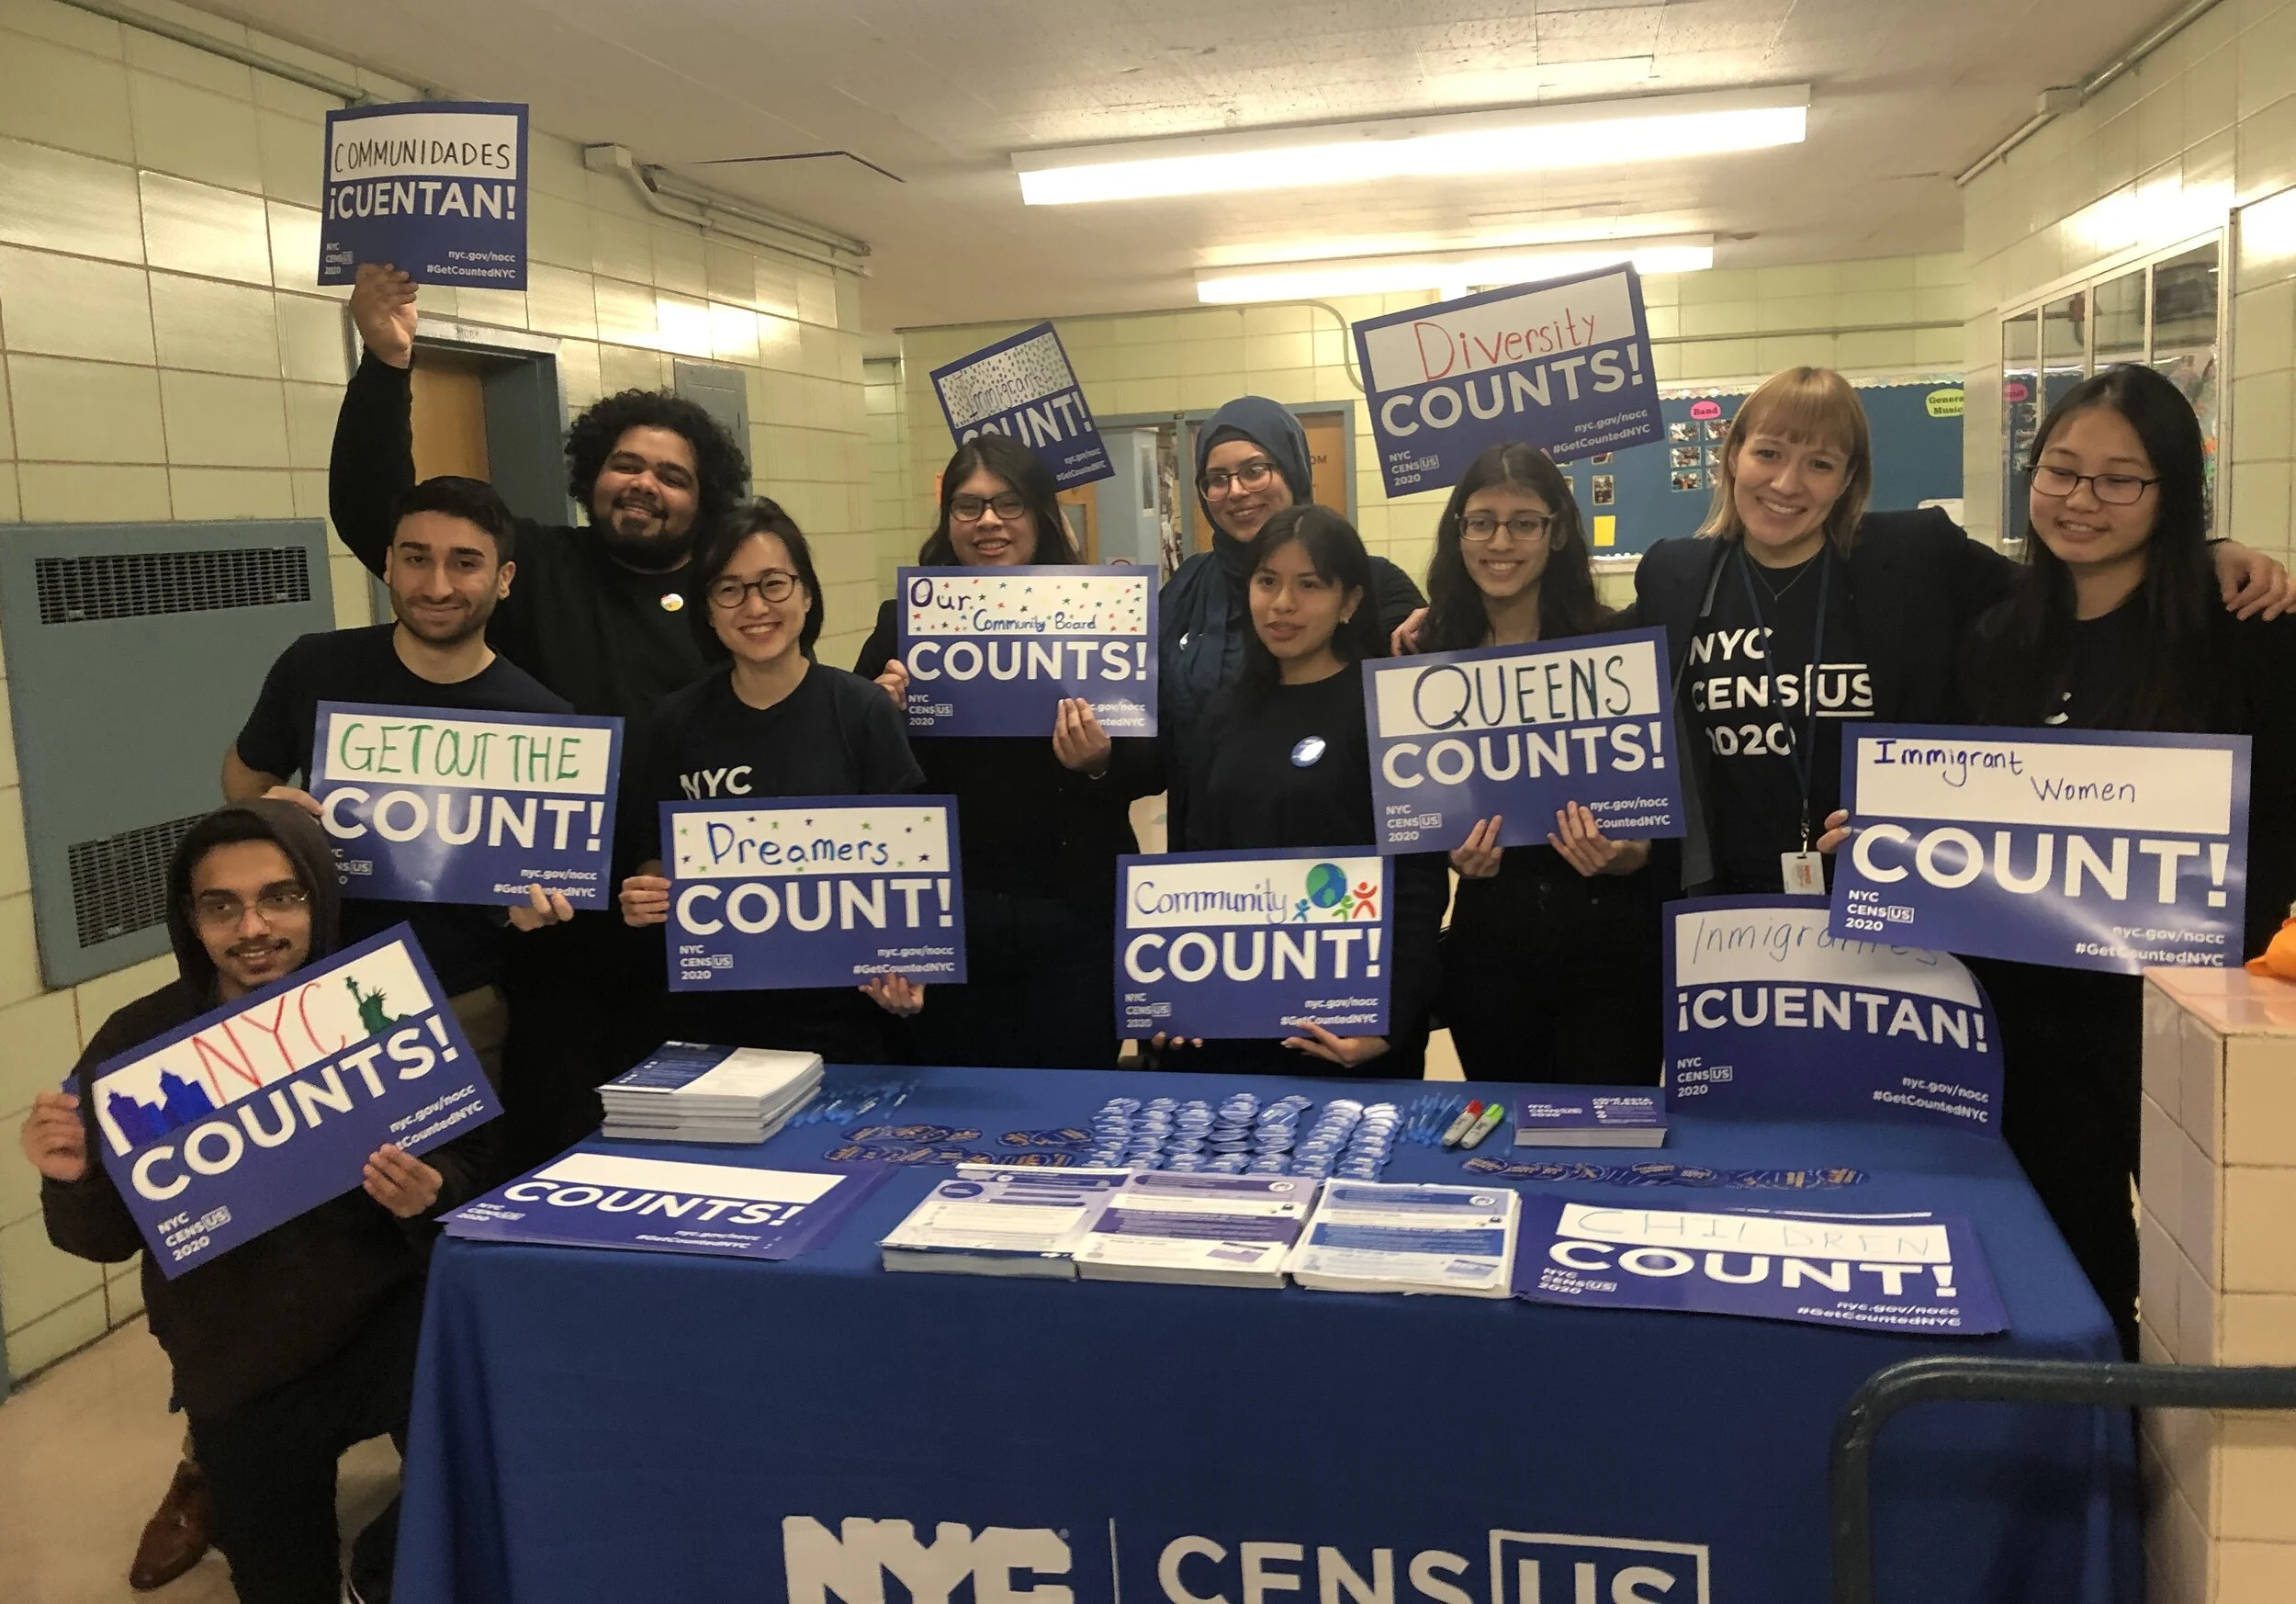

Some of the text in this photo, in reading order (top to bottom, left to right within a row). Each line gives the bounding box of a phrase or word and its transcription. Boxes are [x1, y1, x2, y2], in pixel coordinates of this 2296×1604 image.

[334, 138, 511, 174] COMMUNIDADES
[329, 181, 516, 220] ¡CUENTAN!
[448, 249, 516, 263] nyc.gov/nocc
[426, 265, 516, 279] #GetCountedNYC
[1413, 307, 1595, 381] Diversity
[1380, 343, 1644, 437] COUNTS!
[1929, 396, 1964, 404] Genera
[1574, 409, 1649, 433] nyc.gov/nocc
[1694, 407, 1718, 415] Band
[1553, 424, 1650, 455] #GetCountedNYC
[1389, 450, 1412, 463] NYC
[1391, 456, 1440, 472] CENSUS
[1394, 474, 1422, 486] 2020
[910, 578, 971, 610] Our
[974, 609, 1097, 632] Community Board
[1690, 627, 1774, 666] NYC
[906, 640, 1147, 682] COUNTS!
[908, 695, 929, 703] NYC
[1413, 655, 1631, 730] QUEENS
[908, 704, 953, 717] CENSUS
[1090, 701, 1146, 712] c.gov/nocc
[909, 717, 935, 726] 2020
[1098, 717, 1146, 727] ntedNYC
[1705, 721, 1796, 756] 020
[341, 723, 581, 782] GET OUT THE
[1381, 721, 1665, 789] COUNTS!
[1874, 740, 2023, 787] Immigrant
[680, 765, 752, 800] NYC
[2031, 775, 2136, 803] Women
[1386, 804, 1412, 815] NYC
[1590, 796, 1669, 811] nyc.gov/nocc
[321, 787, 604, 852] COUNT!
[1387, 814, 1442, 829] CENSUS
[1594, 815, 1671, 829] CountedNYC
[706, 821, 889, 865] Dreamers
[1389, 830, 1420, 842] 2020
[335, 860, 373, 875] NSUS
[521, 868, 598, 880] nyc.gov/nocc
[1851, 823, 2231, 908] COUNT!
[676, 878, 953, 935] COUNT!
[1134, 878, 1287, 924] Community
[1849, 889, 1879, 902] NYC
[1847, 903, 1914, 922] CENSUS
[1845, 918, 1884, 932] 2020
[2112, 926, 2225, 944] nyc.gov/nocc
[680, 944, 704, 954] NYC
[877, 945, 955, 957] nyc.gov/nocc
[1693, 919, 1937, 966] Inmigra
[680, 955, 733, 968] CENSUS
[1124, 928, 1381, 982] COUNT!
[681, 969, 712, 980] 2020
[853, 962, 955, 975] #GetCountedNYC
[1124, 993, 1146, 1002] NYC
[1126, 1018, 1153, 1028] 2020
[1678, 987, 1988, 1053] ¡CUENTAN!
[192, 982, 346, 1104] NYC
[1677, 1056, 1702, 1069] NYC
[1677, 1066, 1733, 1083] CENSUS
[1677, 1084, 1708, 1097] 2020
[1902, 1075, 1989, 1103] nyc.gov/nocc
[131, 1014, 459, 1202] COUNTS!
[389, 1084, 476, 1133] nyc.gov/nocc
[1873, 1090, 1989, 1124] #GetCountedNYC
[396, 1100, 484, 1150] tCountedNYC
[503, 1181, 805, 1226] COUNTS!
[157, 1211, 190, 1234] NYC
[165, 1205, 231, 1247] CENSUS
[1578, 1210, 1930, 1258] CHILDREN
[173, 1236, 210, 1261] 2020
[1543, 1267, 1579, 1279] NYC
[1549, 1240, 1956, 1297] COUNT!
[782, 1515, 1074, 1604] NYC
